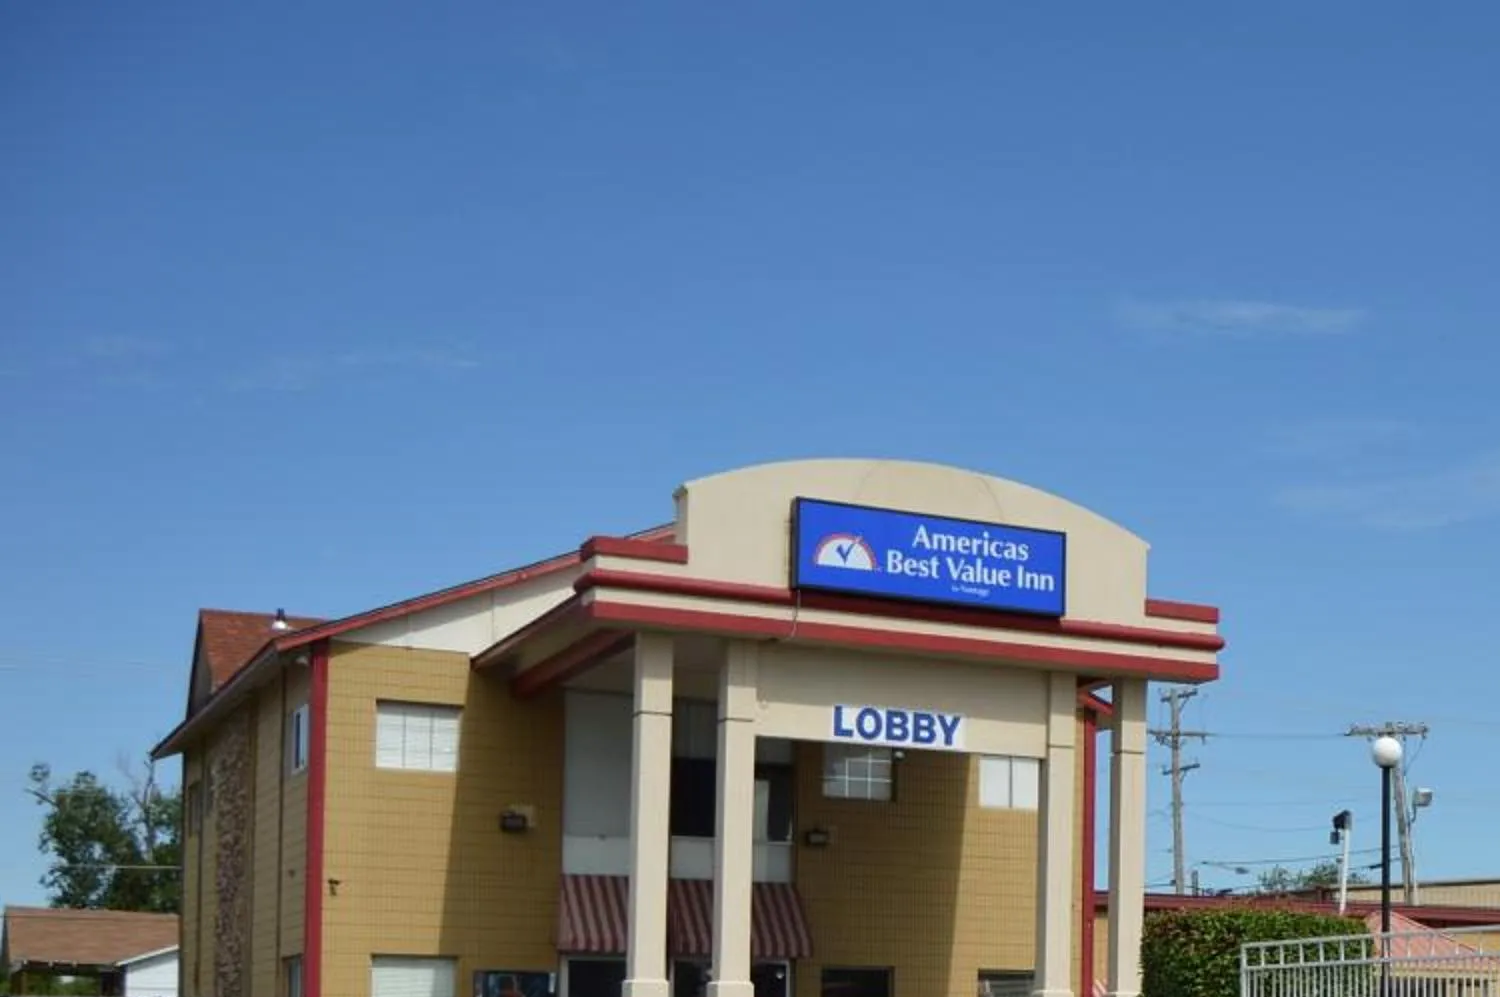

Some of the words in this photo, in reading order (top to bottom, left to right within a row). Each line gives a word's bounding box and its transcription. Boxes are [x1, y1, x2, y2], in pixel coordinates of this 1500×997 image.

[912, 524, 1029, 561] Americas
[887, 549, 940, 578] Best
[946, 558, 1011, 586] Value
[1017, 565, 1055, 592] Inn
[833, 705, 961, 746] LOBBY
